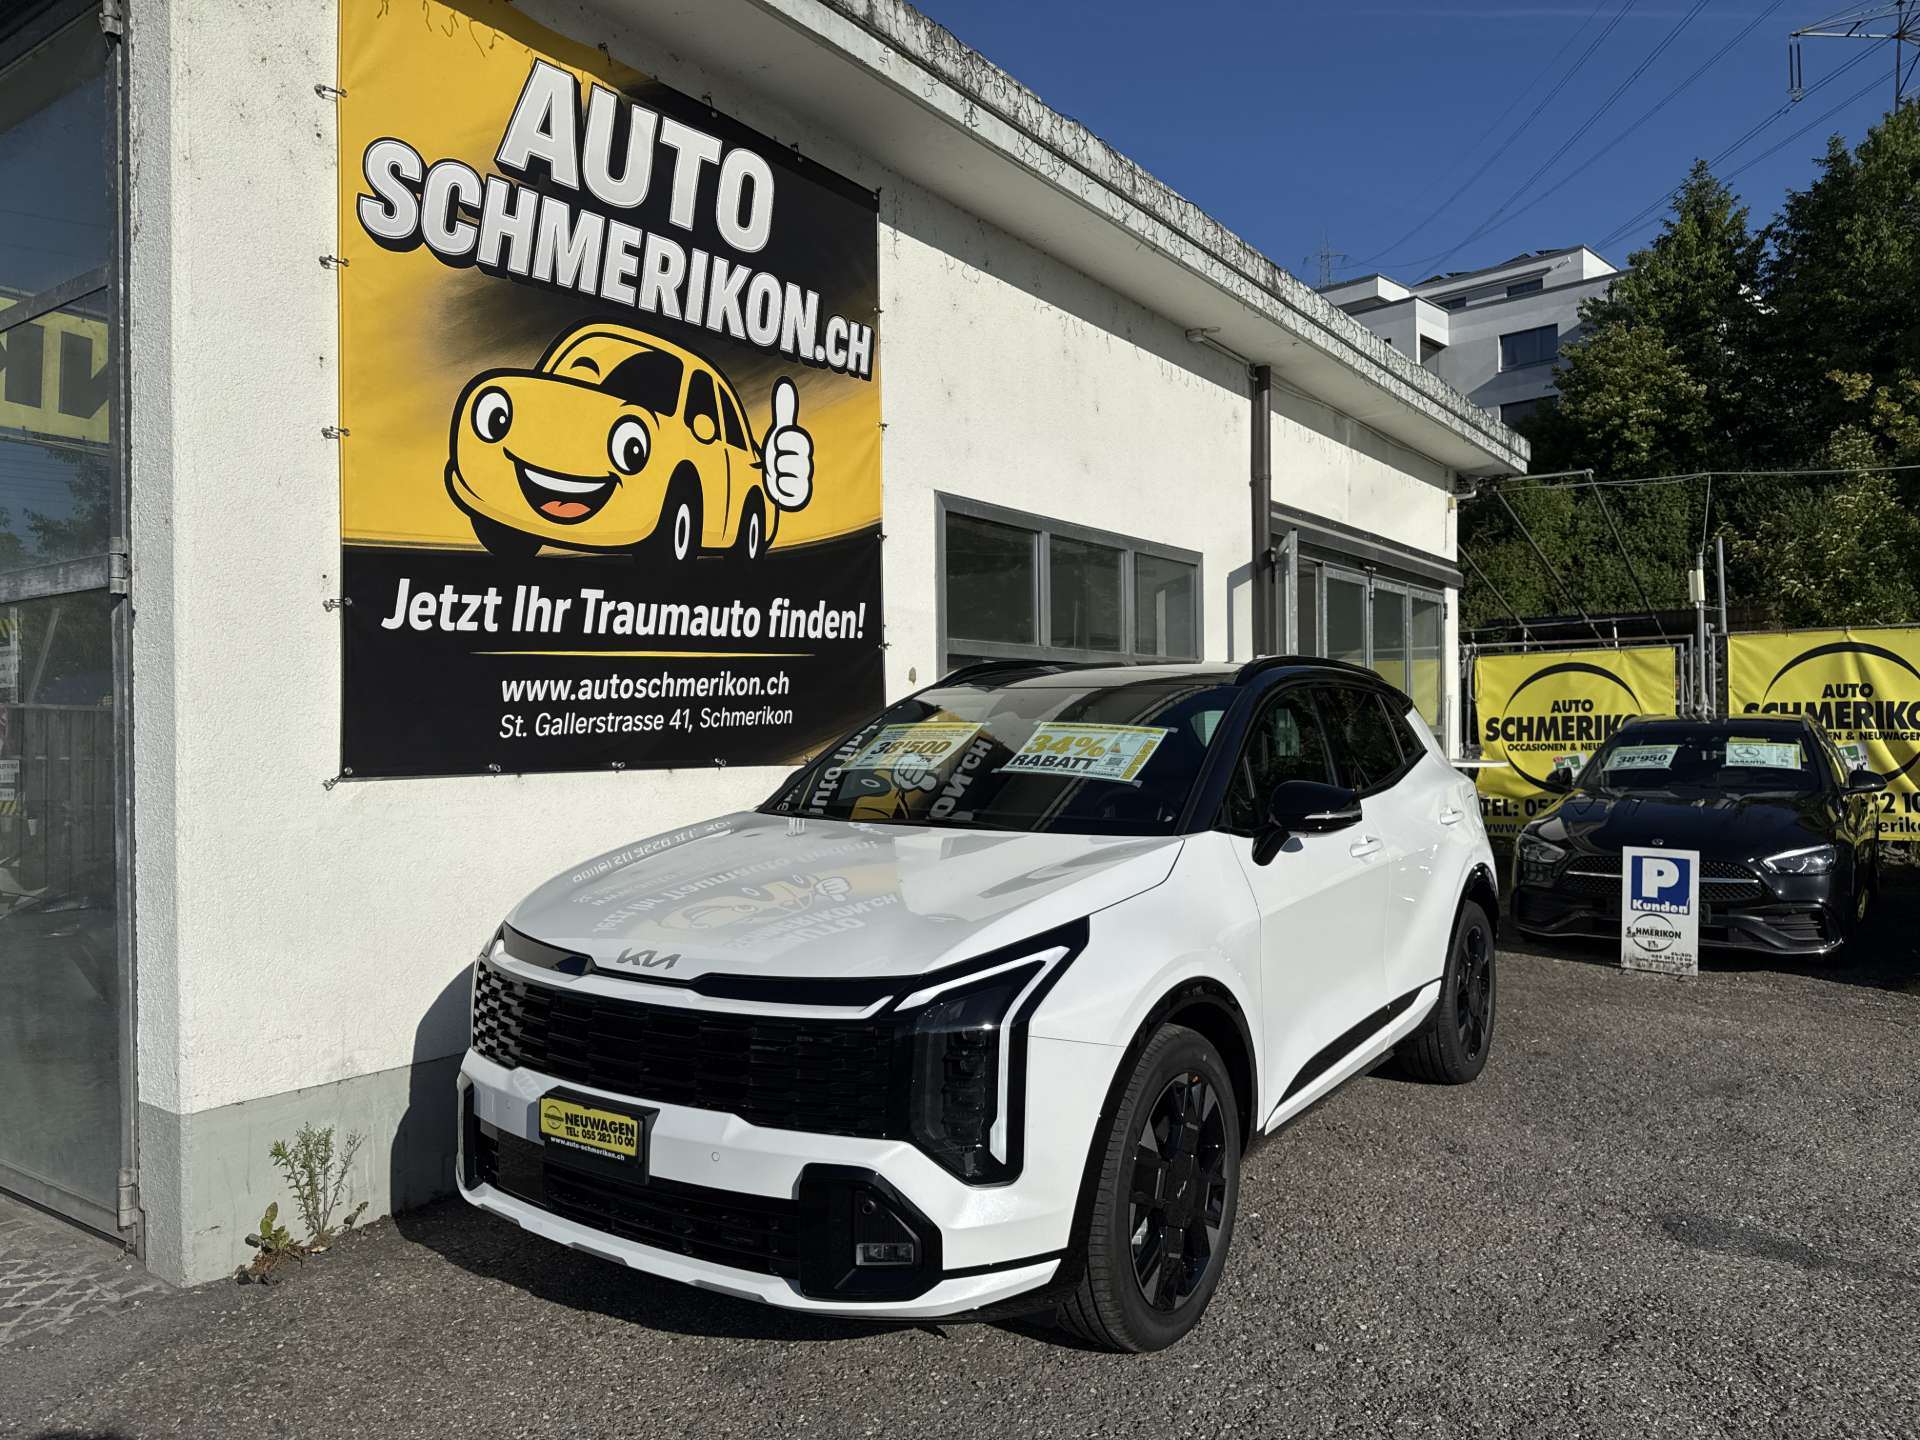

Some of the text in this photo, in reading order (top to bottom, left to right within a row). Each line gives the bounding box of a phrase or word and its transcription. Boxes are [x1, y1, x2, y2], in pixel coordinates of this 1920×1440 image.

[498, 60, 775, 252] AUTO
[360, 140, 873, 376] SCHMERIKON.CH
[381, 578, 867, 640] Jetzt Ihr Traumauto finden!
[501, 671, 790, 702] www.autoschmerikon.ch
[1822, 683, 1874, 699] AUTO
[1550, 699, 1594, 714] AUTO
[499, 706, 793, 739] St. Gallerstrasse 41, Schmerikon
[1485, 713, 1638, 742] SCHMERIK
[870, 740, 953, 755] 38'500
[1023, 735, 1107, 757] 34%
[1507, 743, 1567, 752] OCCASIONEN
[1570, 742, 1577, 751] &
[1846, 732, 1855, 741] &
[1011, 754, 1099, 770] RABATT
[1481, 798, 1519, 817] TEL:
[1642, 858, 1679, 898] P
[1632, 899, 1689, 914] Kunden
[564, 1112, 635, 1138] NEUWAGEN
[565, 1126, 635, 1148] TEL: 055 282 10 00
